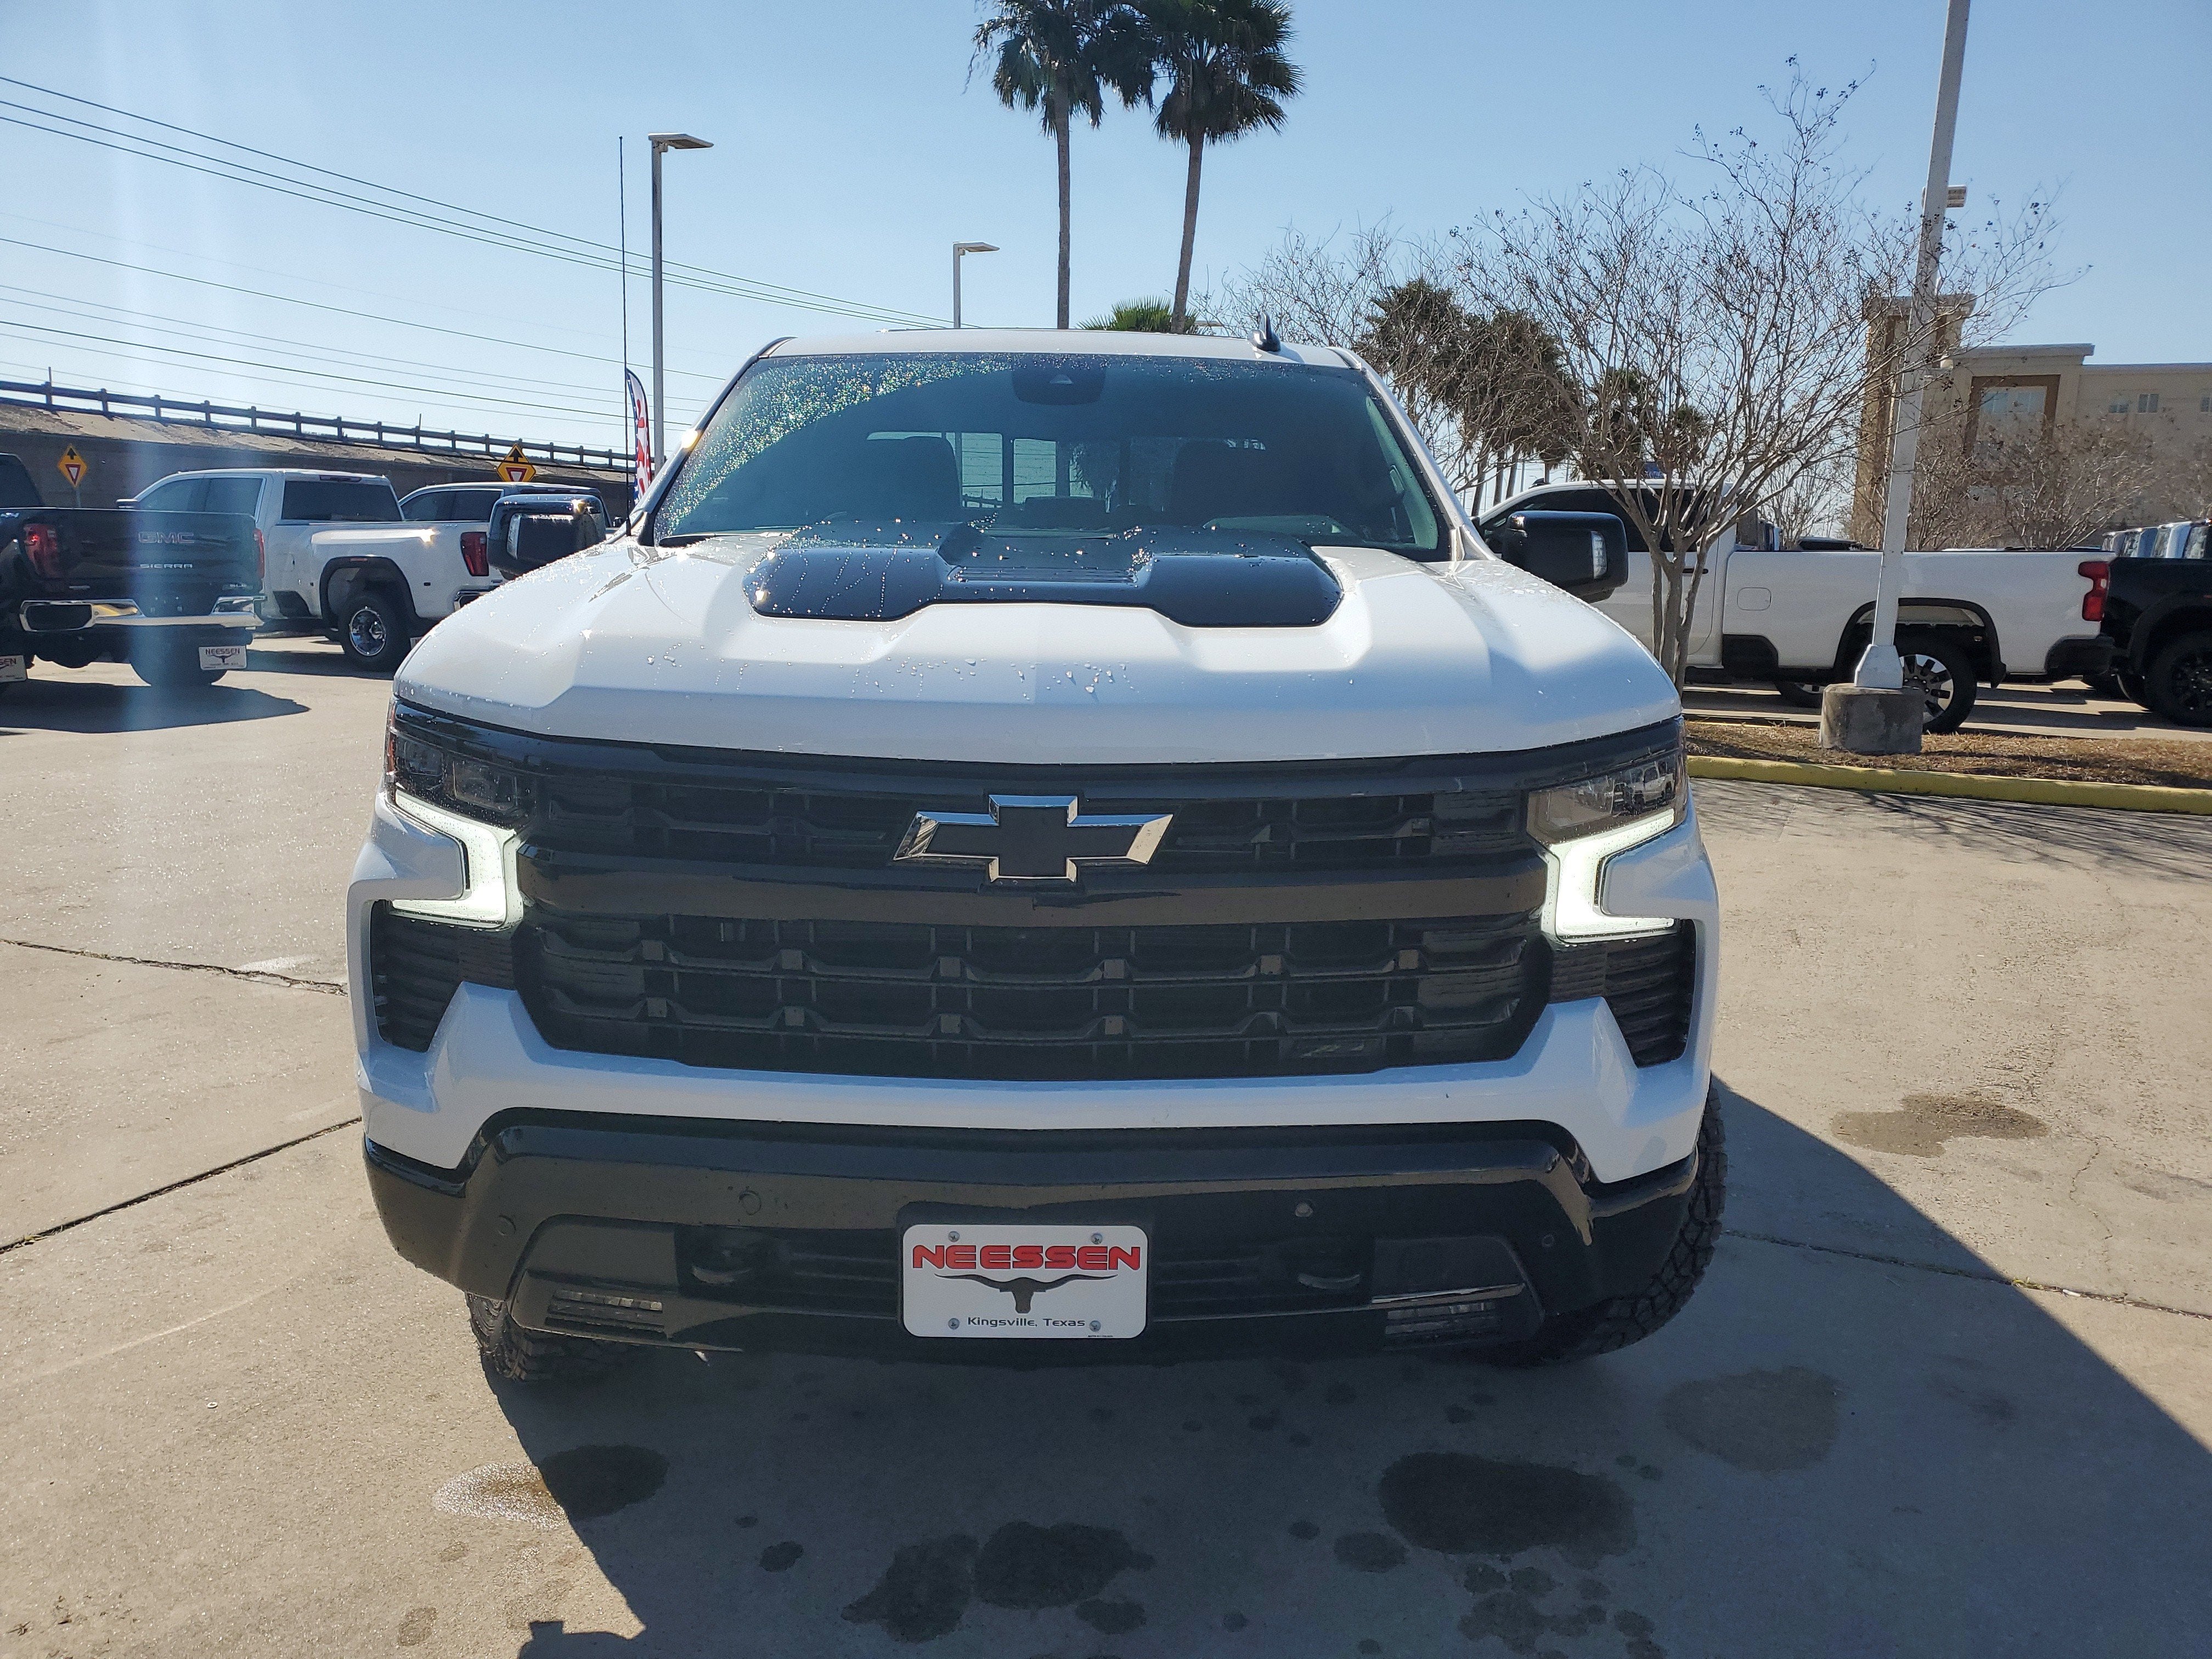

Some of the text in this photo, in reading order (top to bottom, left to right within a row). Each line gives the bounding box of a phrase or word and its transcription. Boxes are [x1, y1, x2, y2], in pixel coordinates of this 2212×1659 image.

[138, 531, 194, 544] GMC
[912, 1245, 1141, 1271] NEESSEN
[968, 1317, 1086, 1328] Kingsville, Texas
